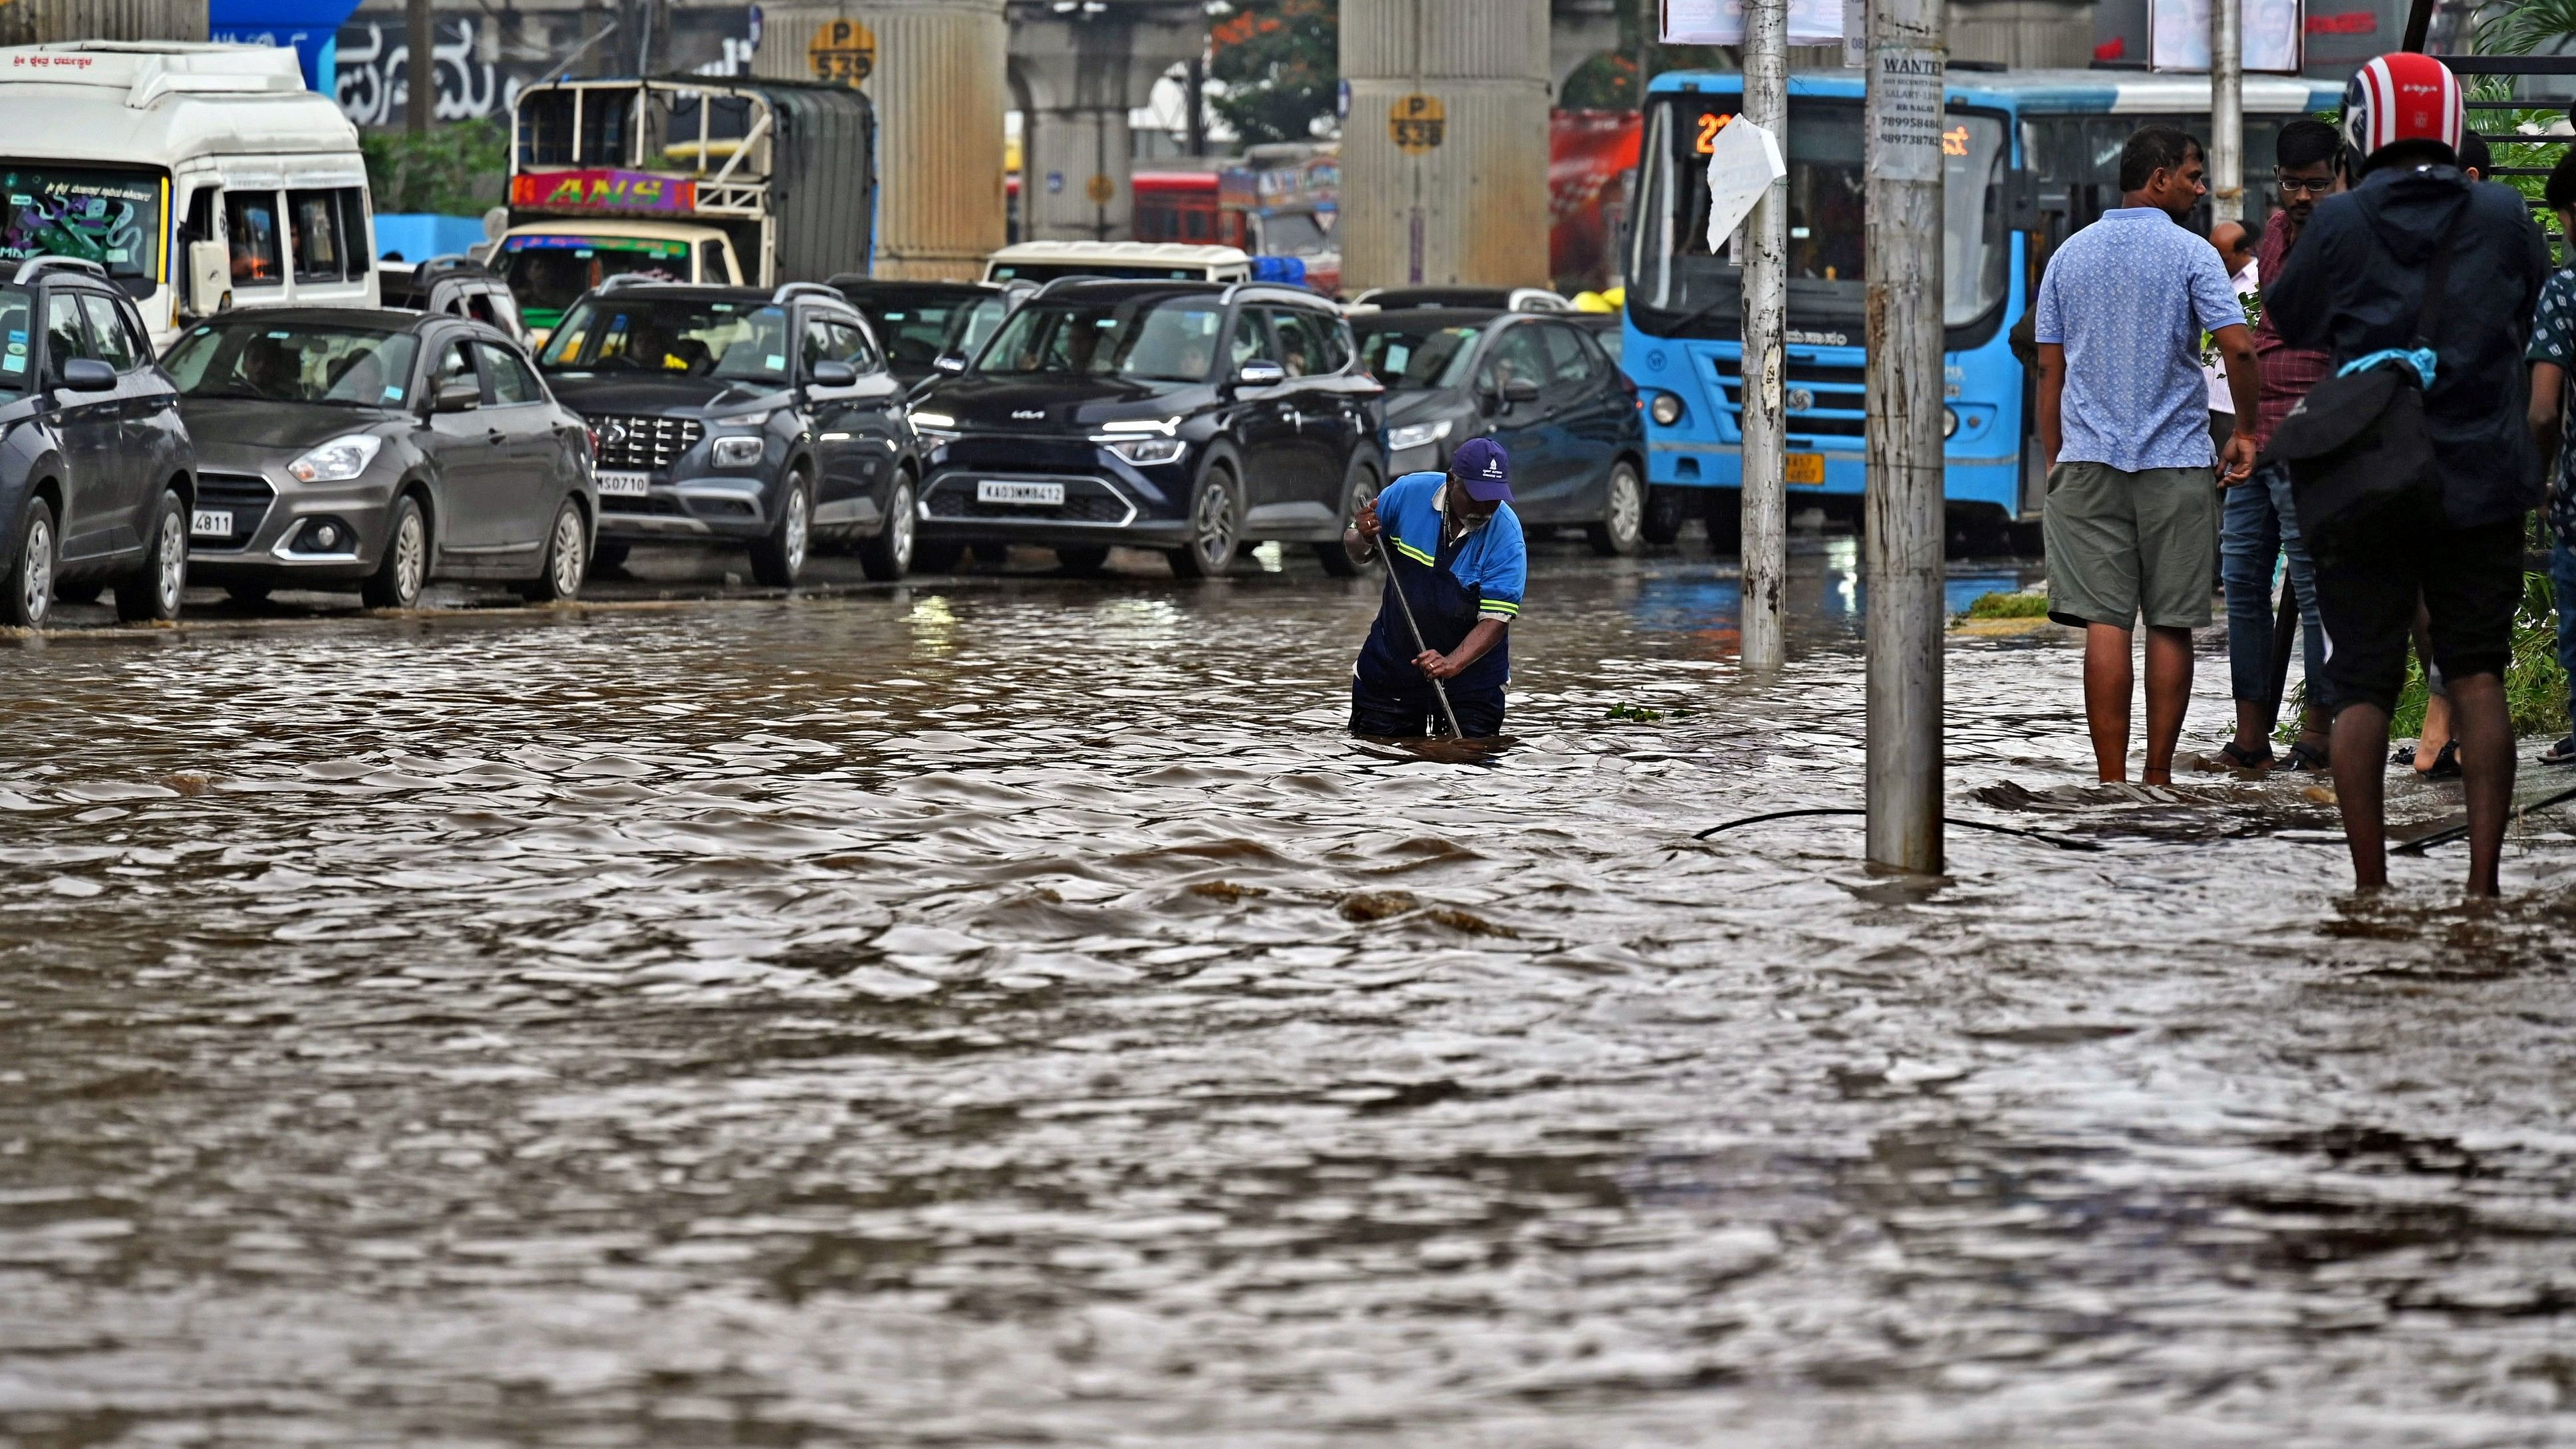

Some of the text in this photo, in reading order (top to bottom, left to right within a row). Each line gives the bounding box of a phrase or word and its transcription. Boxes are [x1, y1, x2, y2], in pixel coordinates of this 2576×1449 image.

[834, 23, 851, 45] P
[817, 55, 872, 80] 539
[1410, 97, 1426, 115] P
[1397, 121, 1441, 146] 538
[195, 513, 229, 532] 4811
